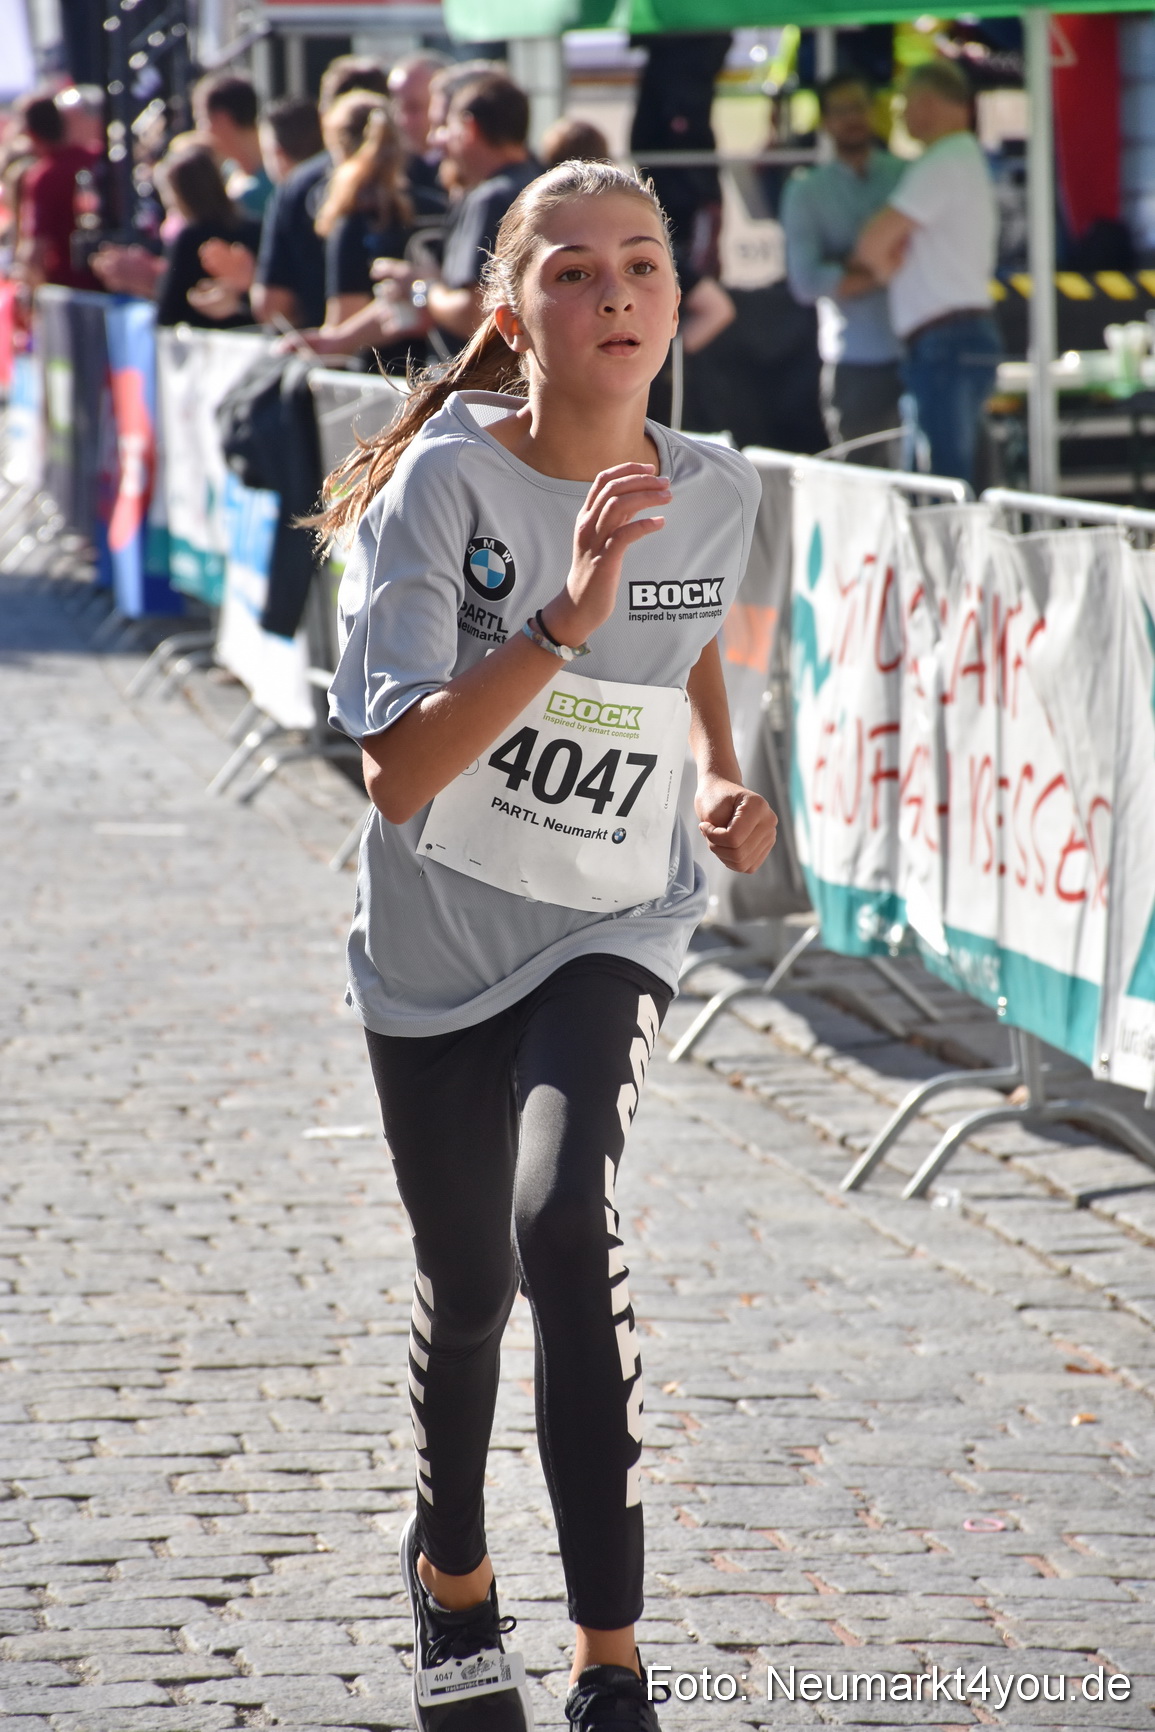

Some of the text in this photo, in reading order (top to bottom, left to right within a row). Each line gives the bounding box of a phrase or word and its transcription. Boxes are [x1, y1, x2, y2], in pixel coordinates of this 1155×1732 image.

[629, 577, 725, 610] BOCK
[460, 601, 509, 634] PARTL
[628, 609, 722, 622] inspired by smart concepts
[543, 713, 640, 740] inspired by smart concepts
[545, 690, 643, 730] BOCK
[488, 726, 658, 818] 4047
[491, 796, 609, 840] PARTL Neumarkt
[434, 1672, 453, 1682] 4047
